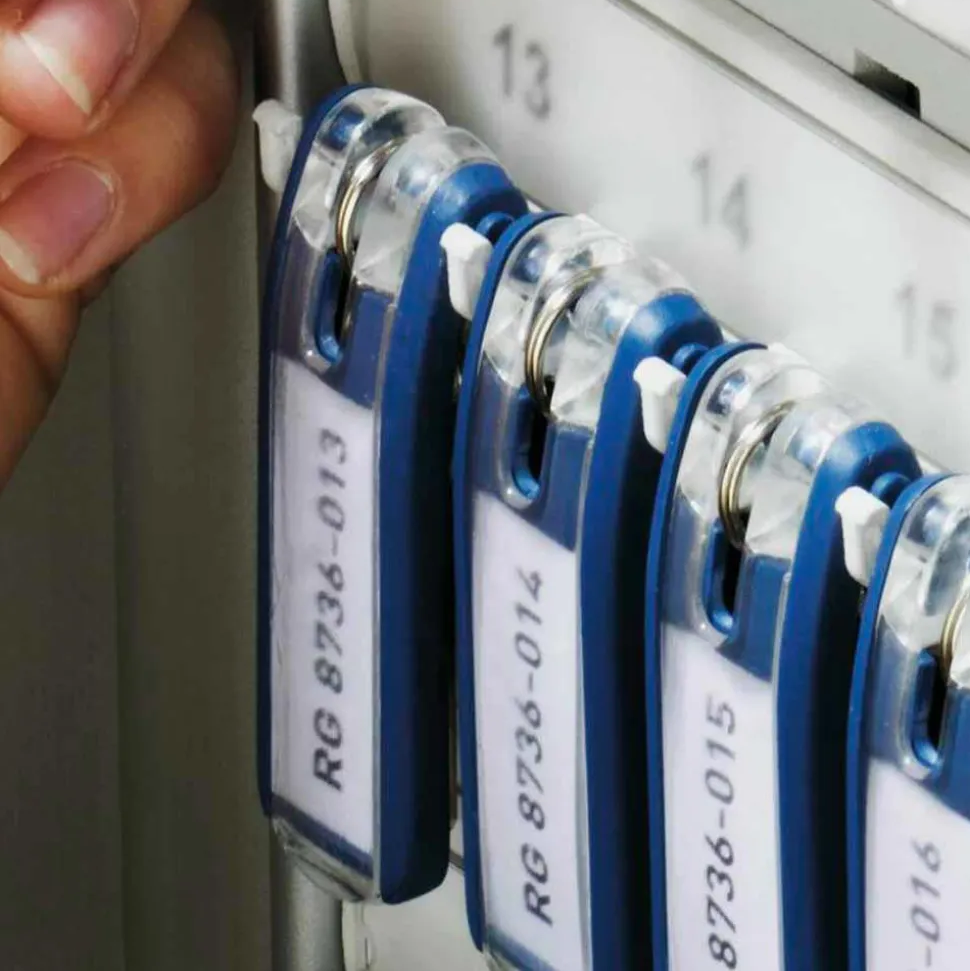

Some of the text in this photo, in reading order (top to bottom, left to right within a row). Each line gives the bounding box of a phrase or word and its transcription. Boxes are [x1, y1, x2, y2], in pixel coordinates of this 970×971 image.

[494, 23, 551, 120] 13
[692, 151, 752, 252] 14
[896, 283, 959, 380] 15
[313, 427, 348, 792] RG 8736-013
[514, 566, 553, 926] RG 8736-014
[705, 694, 738, 970] 8736-015
